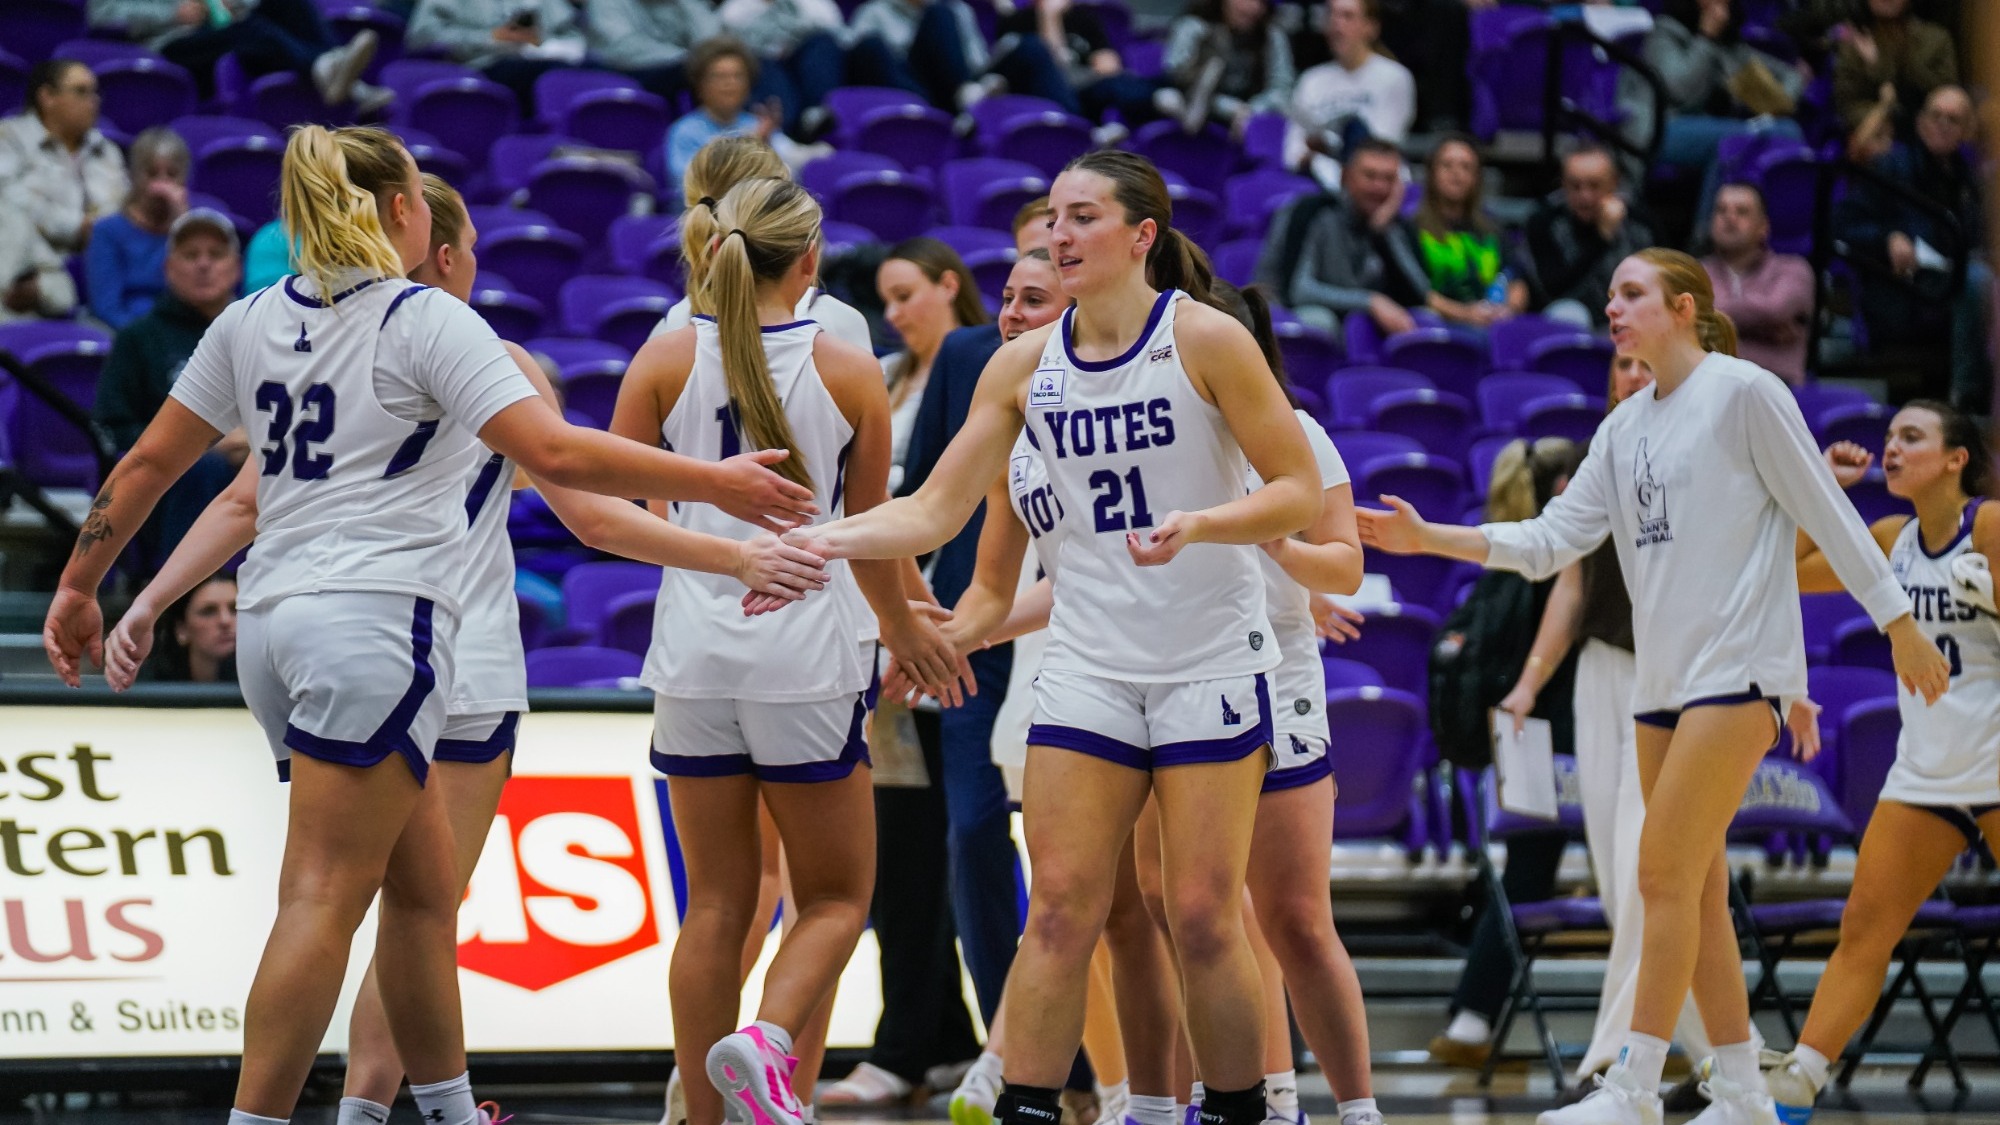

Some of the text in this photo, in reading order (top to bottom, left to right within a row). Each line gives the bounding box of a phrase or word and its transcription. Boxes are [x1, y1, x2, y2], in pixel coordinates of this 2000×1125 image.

[255, 380, 335, 481] 32
[1044, 397, 1176, 458] YOTES
[1088, 465, 1154, 534] 21
[1902, 585, 1977, 622] OTES
[0, 743, 120, 801] st
[69, 1001, 94, 1032] &
[117, 1000, 241, 1032] Suites
